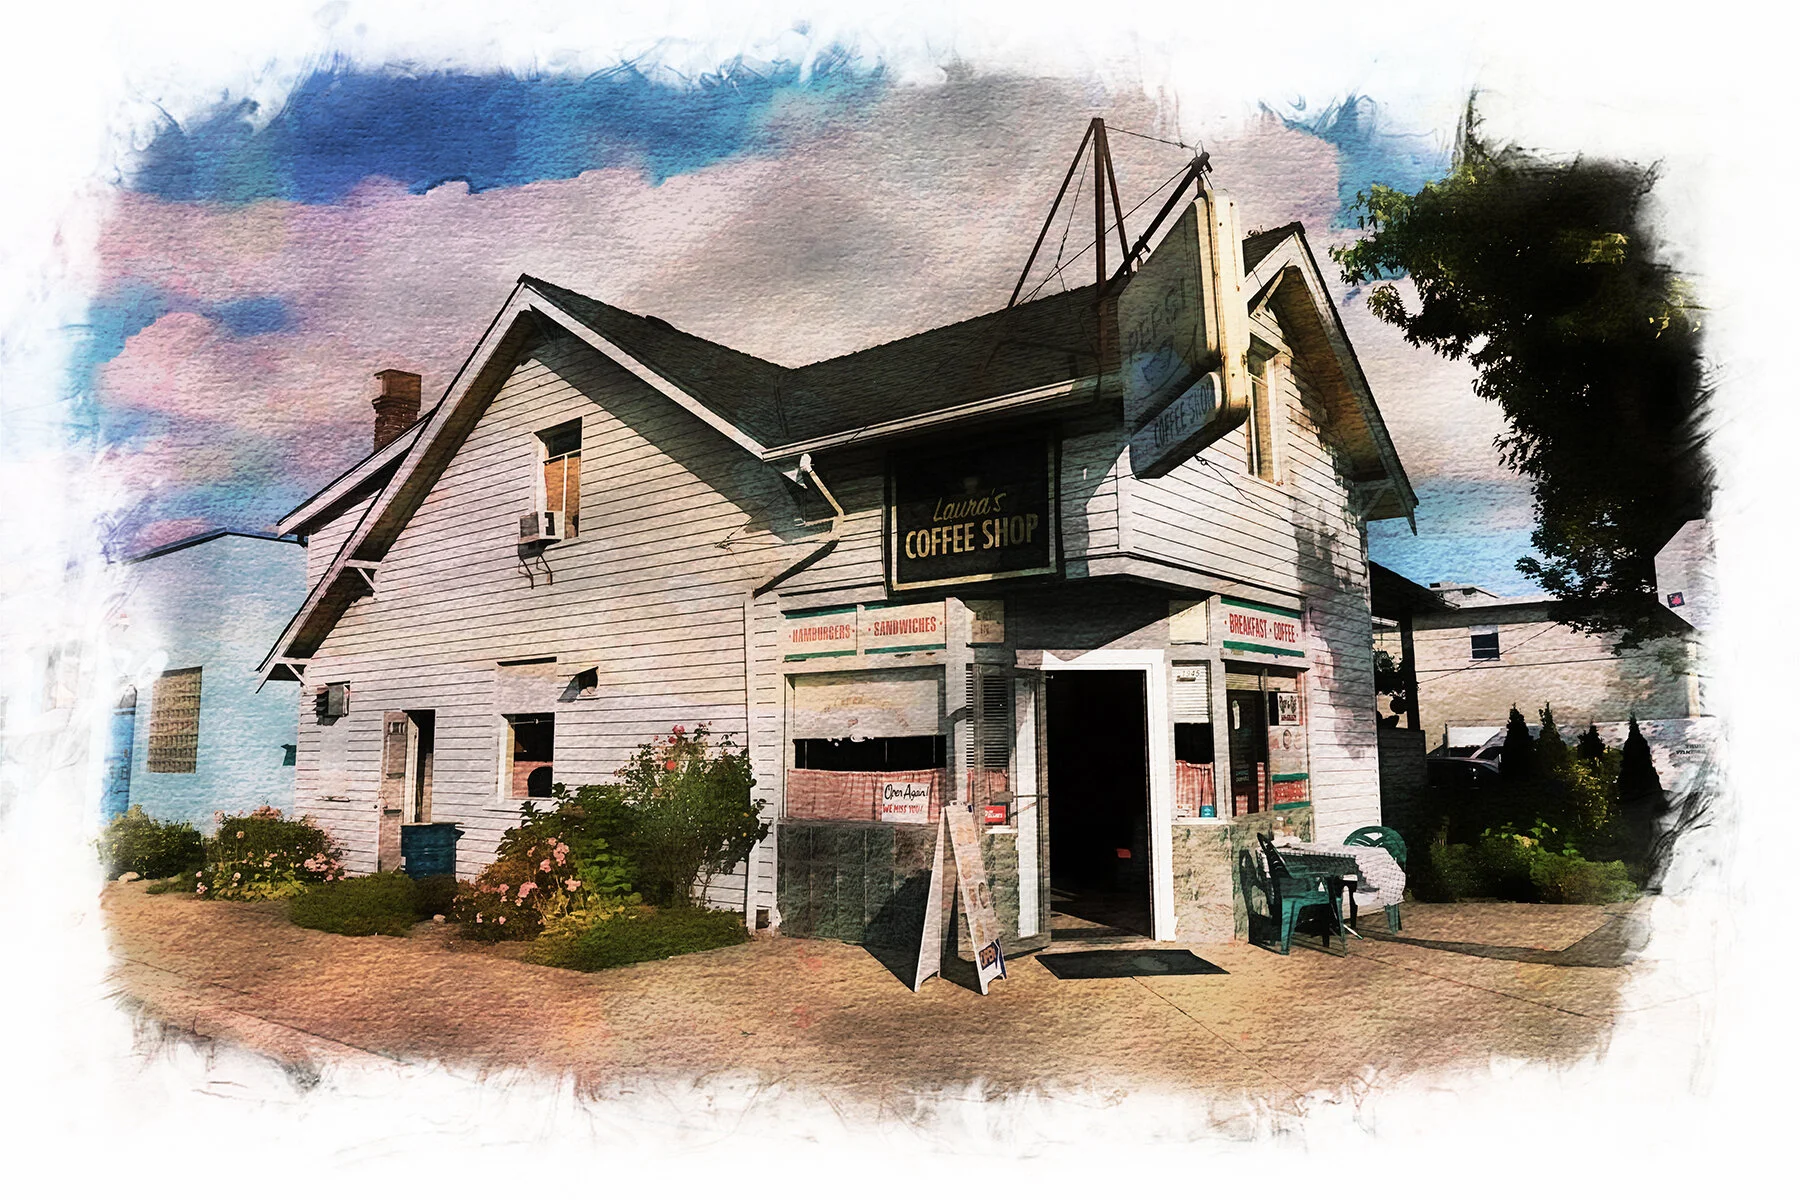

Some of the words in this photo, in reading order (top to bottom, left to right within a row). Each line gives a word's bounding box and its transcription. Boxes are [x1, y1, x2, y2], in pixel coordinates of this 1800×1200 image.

[1153, 401, 1187, 449] COFFEE
[1188, 382, 1216, 425] SHOP
[933, 488, 1007, 522] Laura's
[905, 522, 975, 560] COFFEE
[982, 513, 1039, 550] SHOP
[792, 624, 851, 643] HAMBURGERS
[873, 616, 937, 637] SANDWICHES
[1229, 613, 1268, 639] BREAKFAST
[1273, 621, 1296, 643] COFFEE
[884, 783, 903, 800] Open
[882, 803, 893, 813] WE
[893, 804, 907, 813] MISS
